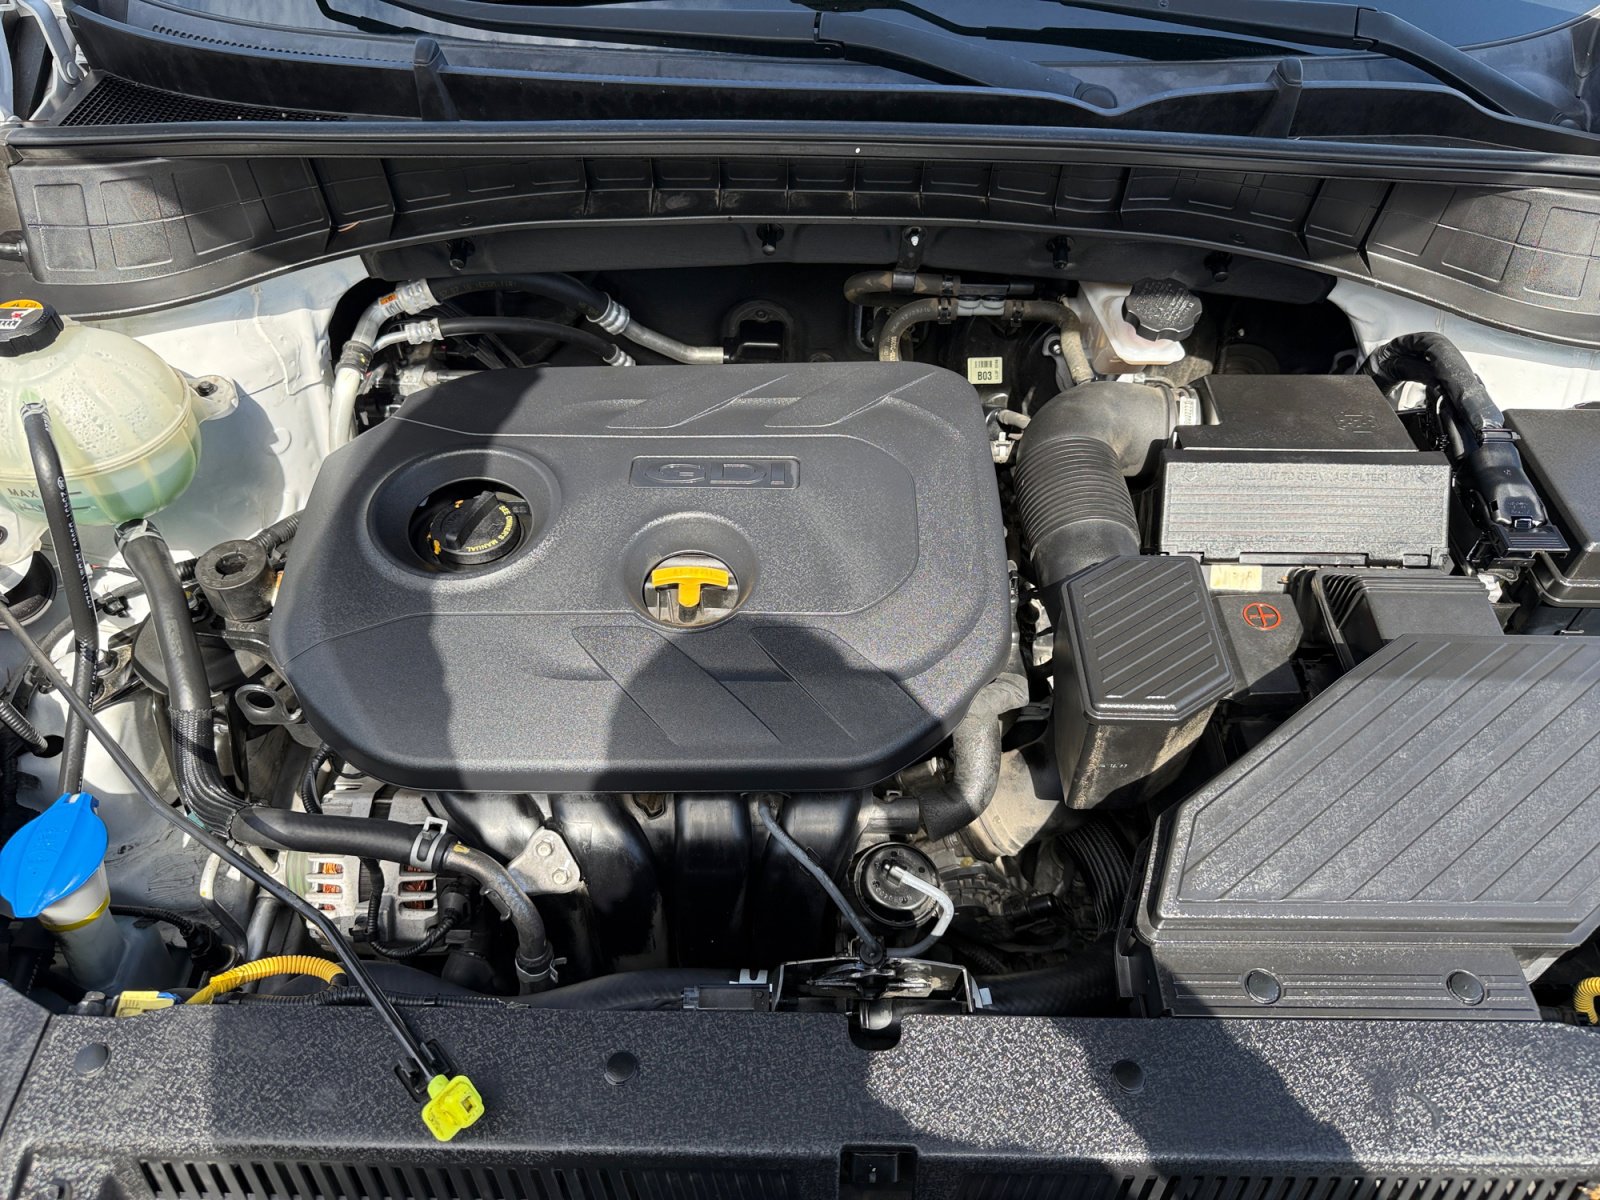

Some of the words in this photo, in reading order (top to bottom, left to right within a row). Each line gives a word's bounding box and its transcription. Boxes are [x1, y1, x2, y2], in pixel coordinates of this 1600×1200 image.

[978, 371, 992, 380] B03
[644, 463, 785, 485] GDI
[7, 488, 38, 498] MAX
[466, 539, 498, 552] MANUAL
